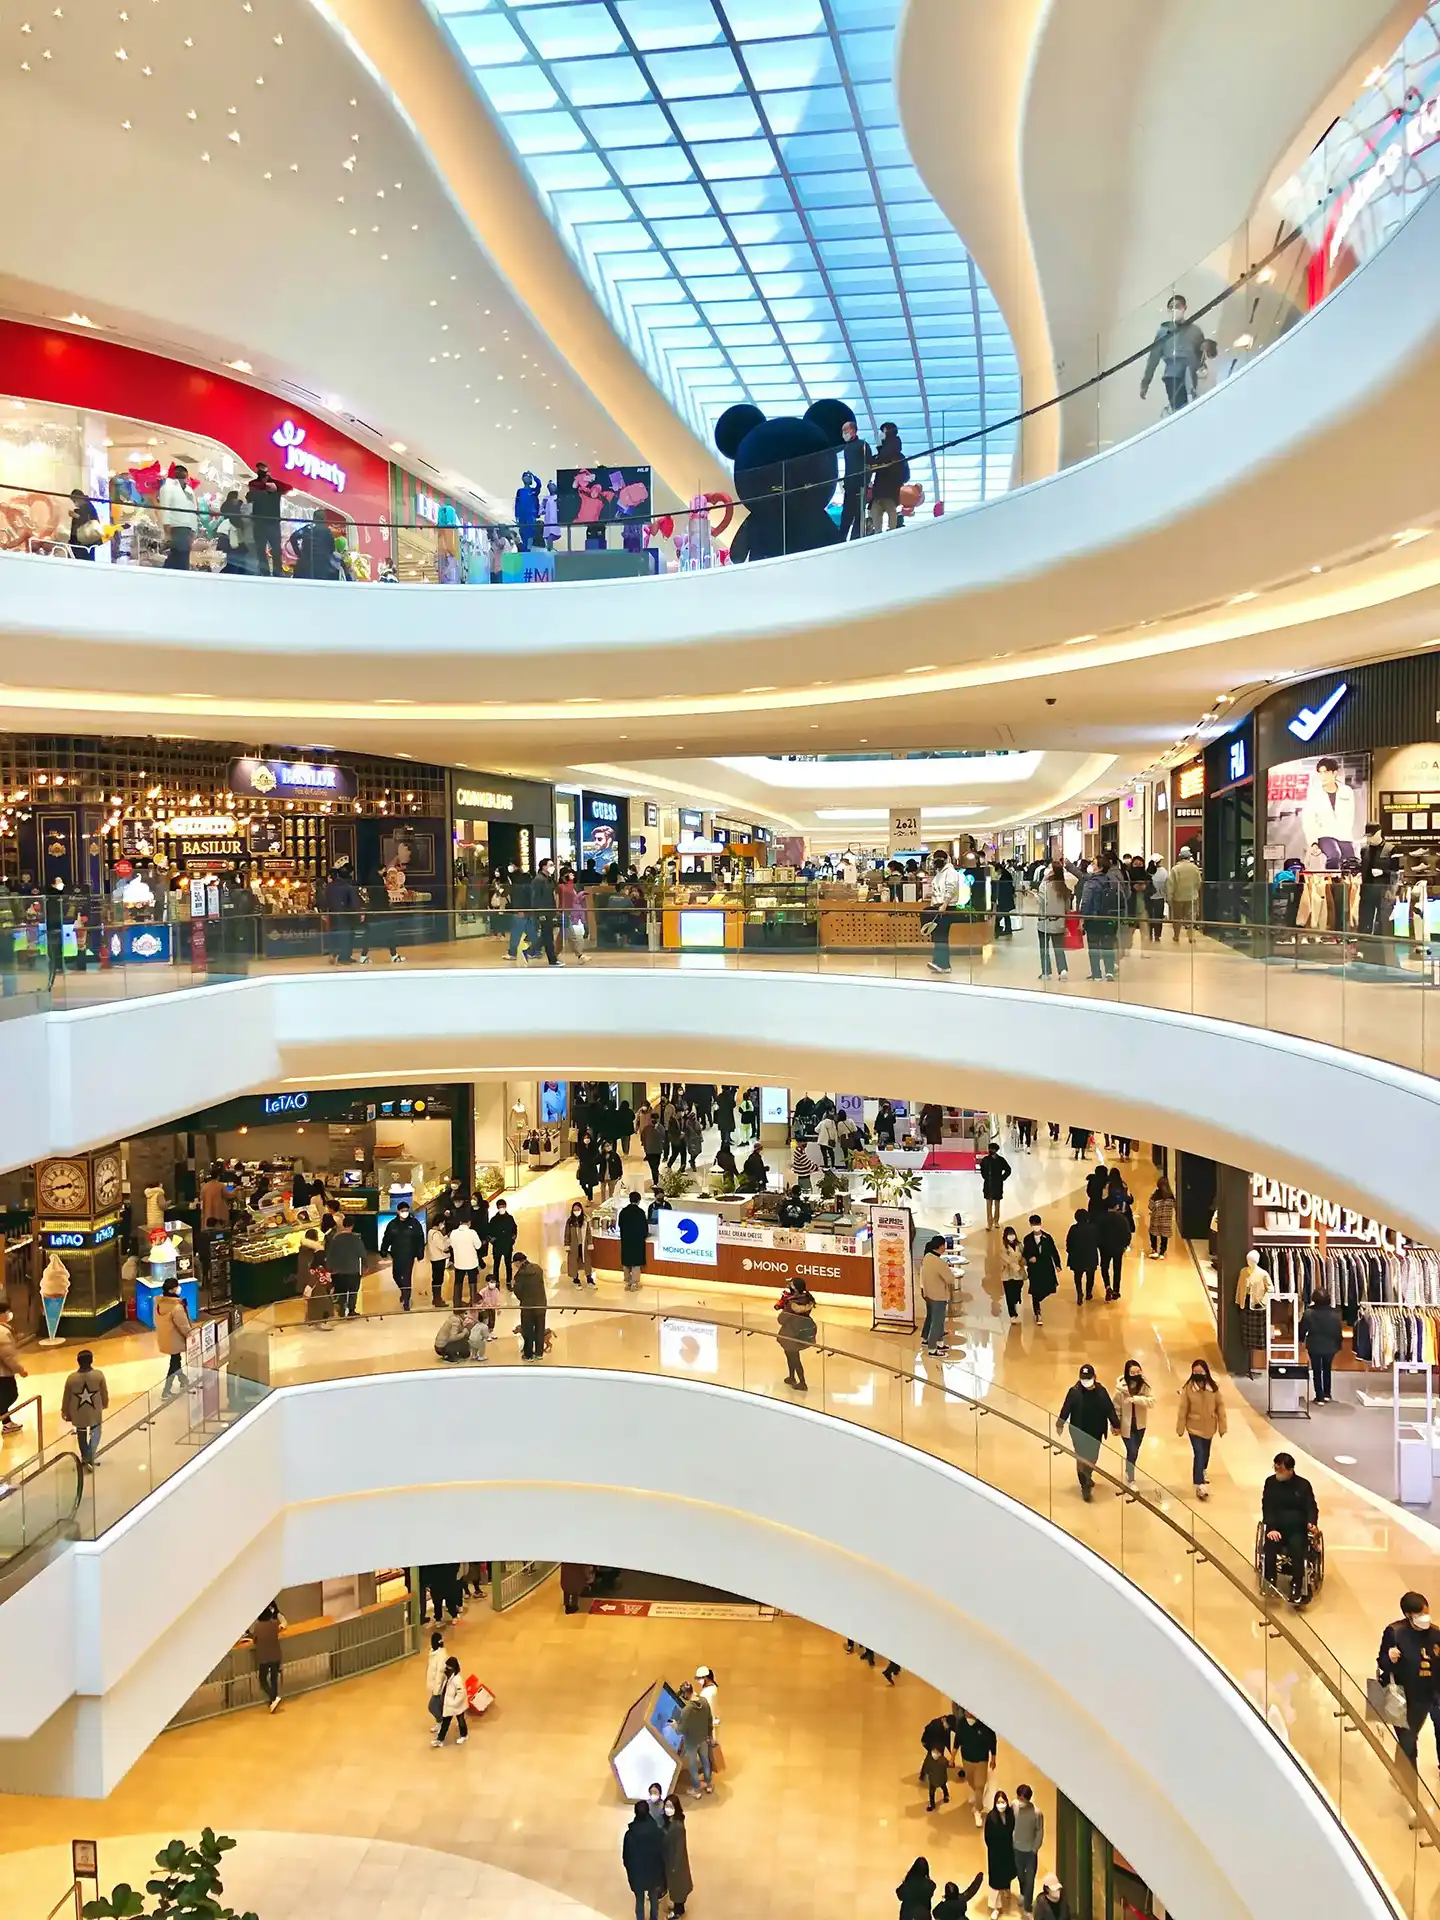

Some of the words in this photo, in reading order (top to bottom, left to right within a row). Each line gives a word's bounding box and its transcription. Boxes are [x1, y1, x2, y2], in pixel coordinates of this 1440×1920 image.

[592, 800, 618, 822] GUESS
[895, 818, 917, 829] 2021
[181, 840, 243, 855] BASILUR
[265, 1092, 308, 1113] LeTAO
[841, 1095, 862, 1109] 50
[1253, 1172, 1342, 1229] PLATFORM
[1342, 1207, 1407, 1257] PLACE
[51, 1234, 84, 1247] LeTAO
[663, 1246, 685, 1255] MONO
[685, 1247, 714, 1258] CHEESE
[753, 1262, 789, 1273] MONO
[795, 1264, 841, 1278] CHEESE
